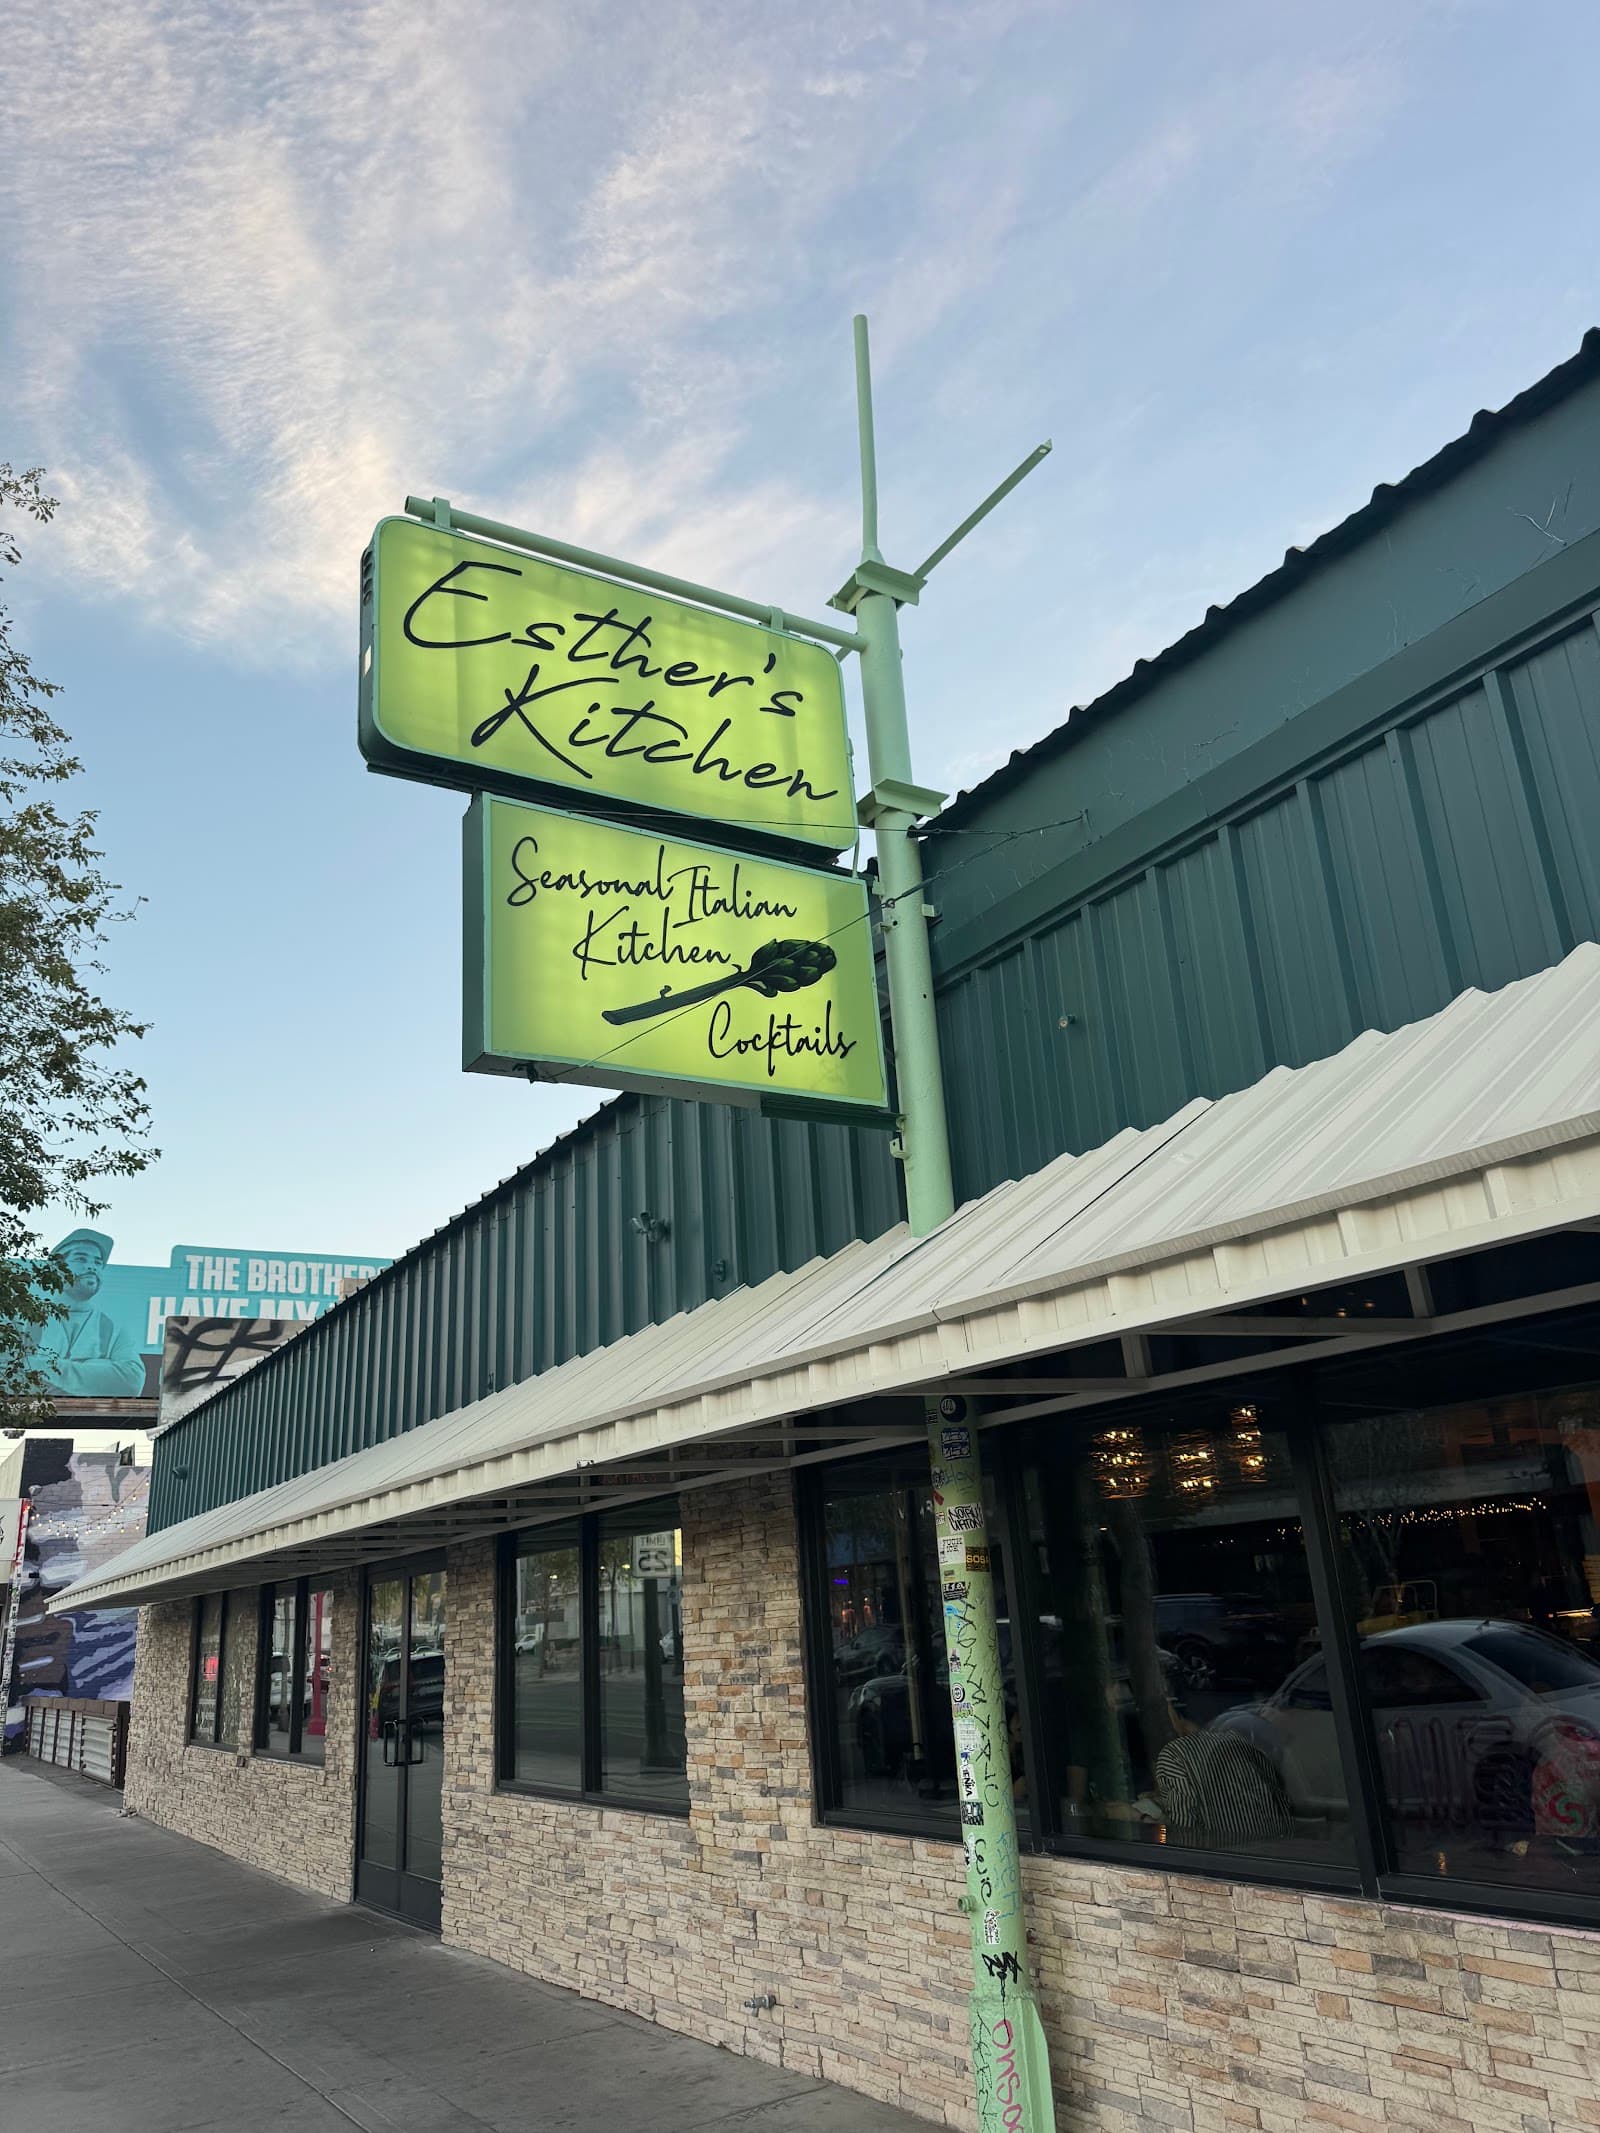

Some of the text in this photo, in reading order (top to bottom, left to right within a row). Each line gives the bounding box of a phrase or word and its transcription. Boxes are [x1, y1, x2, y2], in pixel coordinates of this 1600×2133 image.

[403, 560, 804, 718] Esther's
[470, 663, 839, 801] Kitchen
[506, 836, 797, 929] Seasonal Italian
[572, 905, 731, 981] Kitchen
[708, 1000, 857, 1077] Cocktails
[186, 1255, 241, 1291] THE
